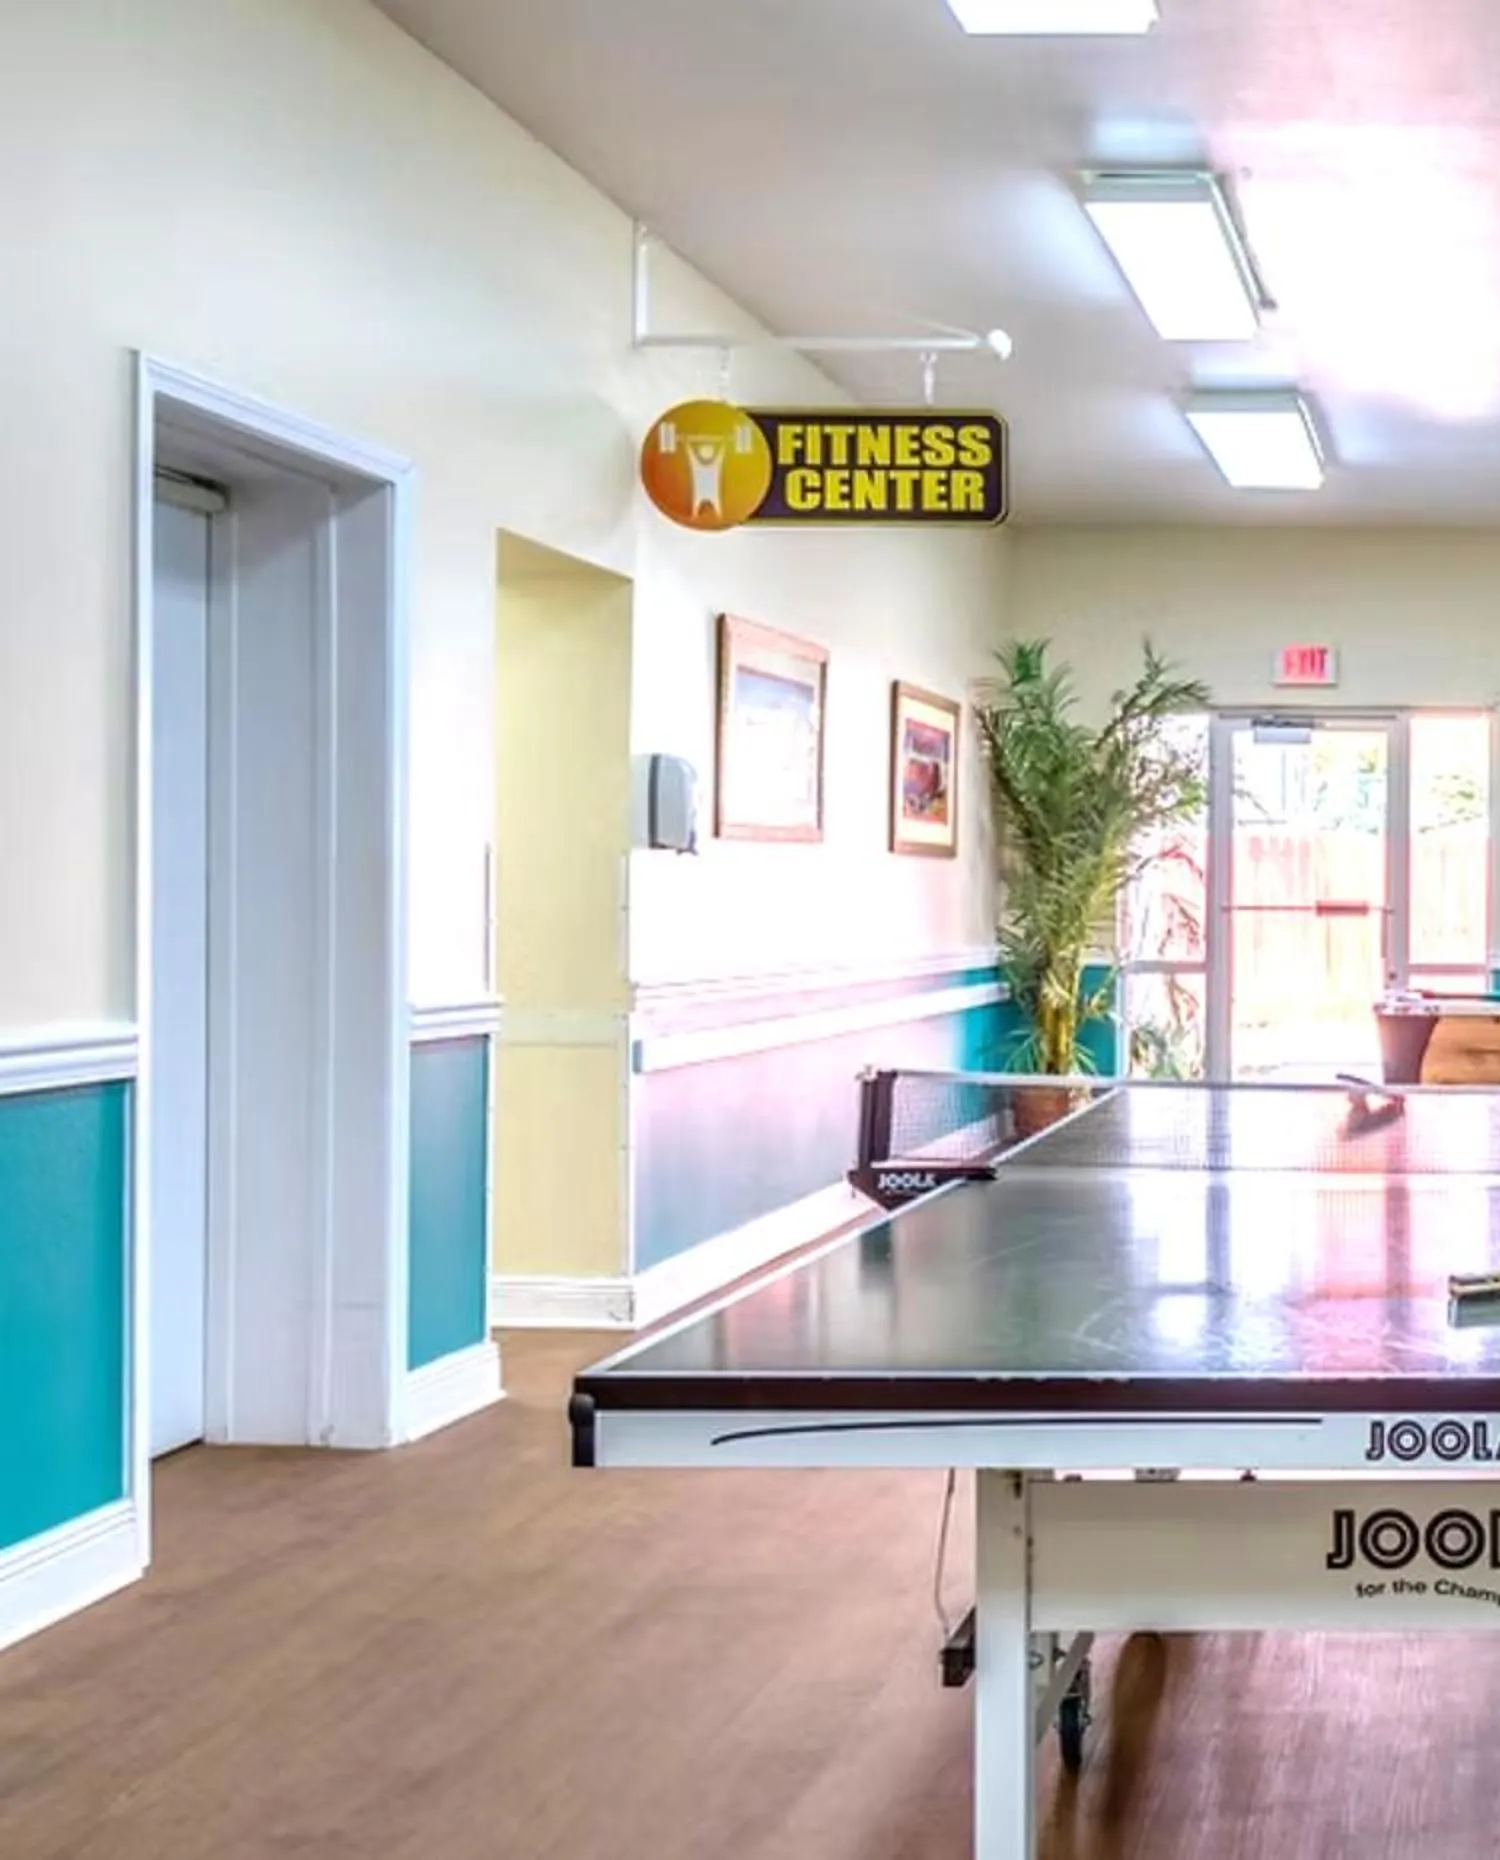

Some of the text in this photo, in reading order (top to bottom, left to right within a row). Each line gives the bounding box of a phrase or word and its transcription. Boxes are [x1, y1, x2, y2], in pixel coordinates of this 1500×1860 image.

[777, 424, 993, 467] FITNESS
[785, 470, 985, 512] CENTER
[1284, 646, 1329, 677] EXIT
[1355, 1581, 1385, 1598] for
[1393, 1578, 1427, 1595] the
